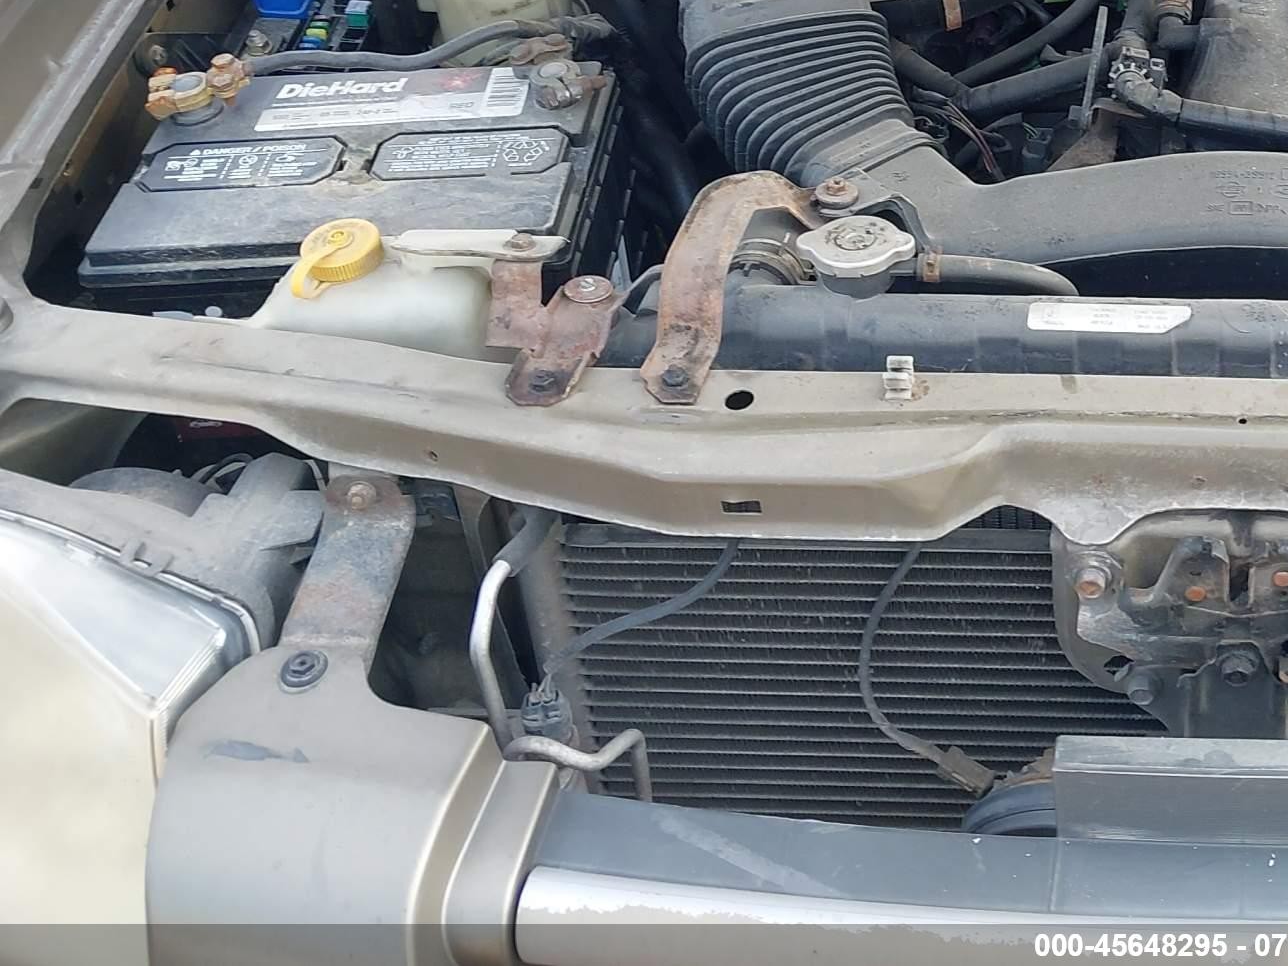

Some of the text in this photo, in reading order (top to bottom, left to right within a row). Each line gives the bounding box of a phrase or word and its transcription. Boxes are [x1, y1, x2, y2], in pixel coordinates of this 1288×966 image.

[276, 78, 408, 99] DieHard
[202, 147, 253, 156] DANGER
[262, 144, 307, 152] POISON
